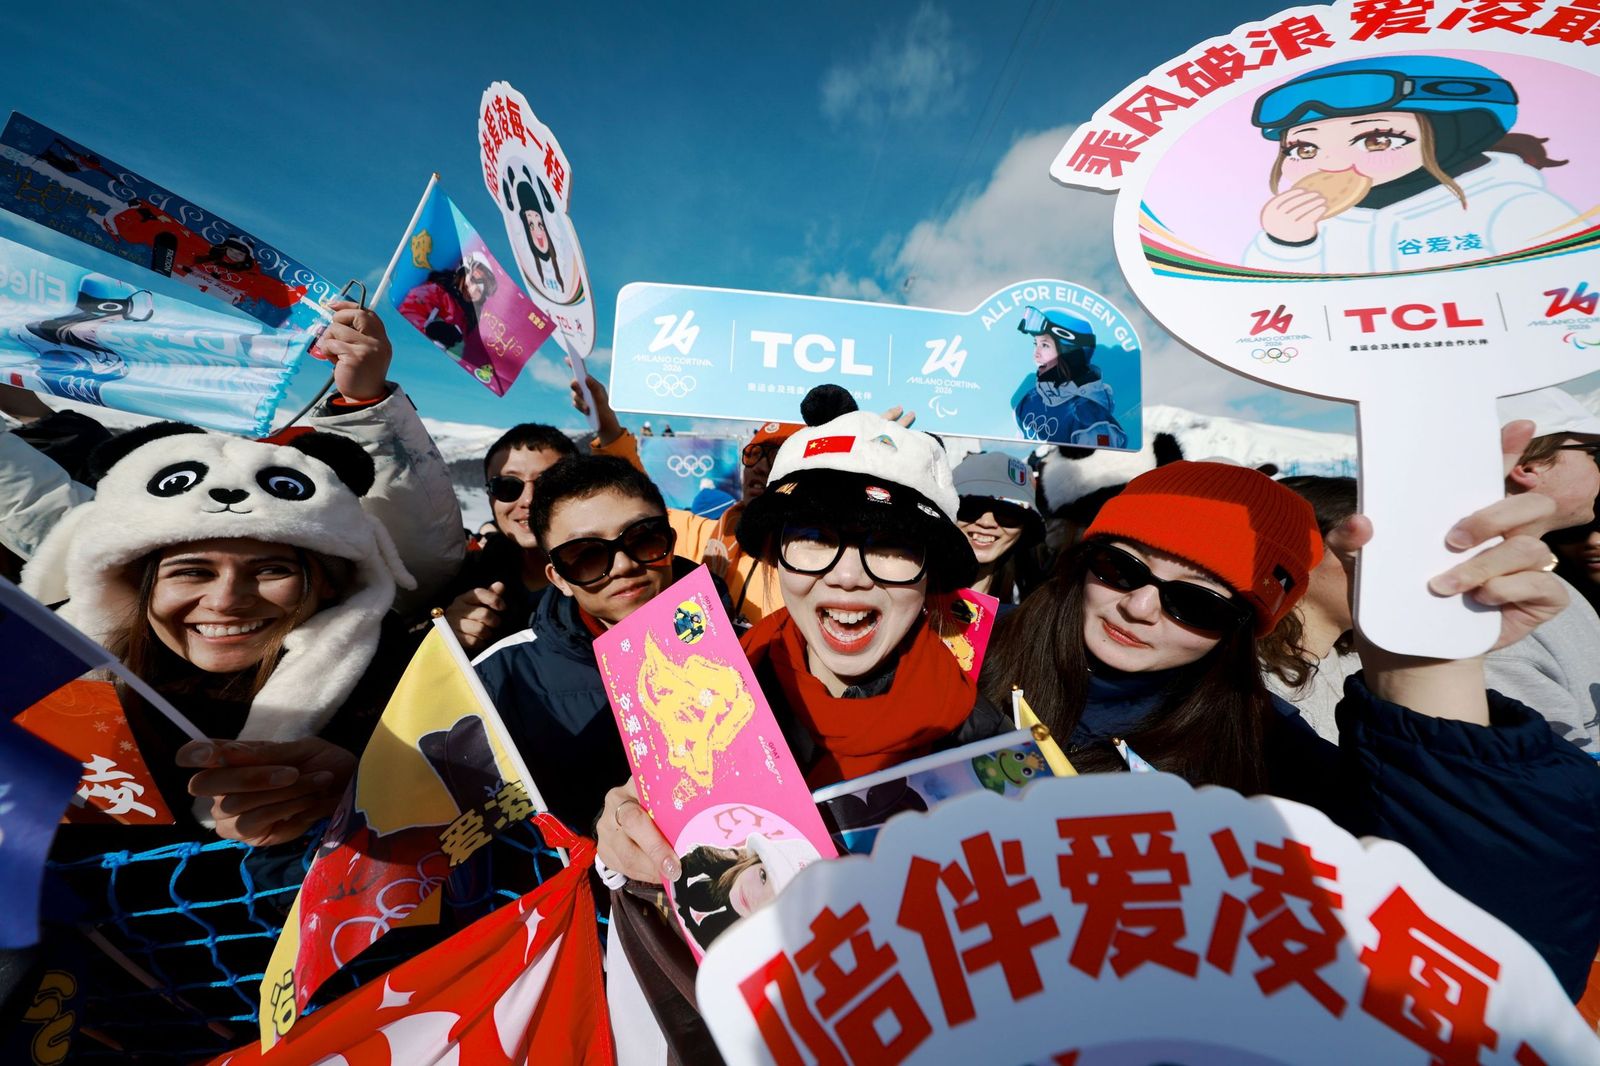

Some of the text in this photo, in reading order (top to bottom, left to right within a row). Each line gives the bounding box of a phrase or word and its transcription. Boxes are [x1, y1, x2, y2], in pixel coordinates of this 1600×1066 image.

[1067, 14, 1336, 178] 乘风破浪
[1397, 232, 1483, 255] 谷爱凌
[981, 286, 1137, 352] ALL FOR EILEEN GU
[1344, 302, 1484, 333] TCL
[633, 354, 715, 367] MILANO CORTINA
[750, 330, 873, 376] TCL
[906, 376, 981, 390] MILANO CORTINA
[935, 386, 953, 394] 2026
[619, 692, 648, 760] 谷爱凌
[737, 810, 1550, 1066] 陪伴爱凌每
